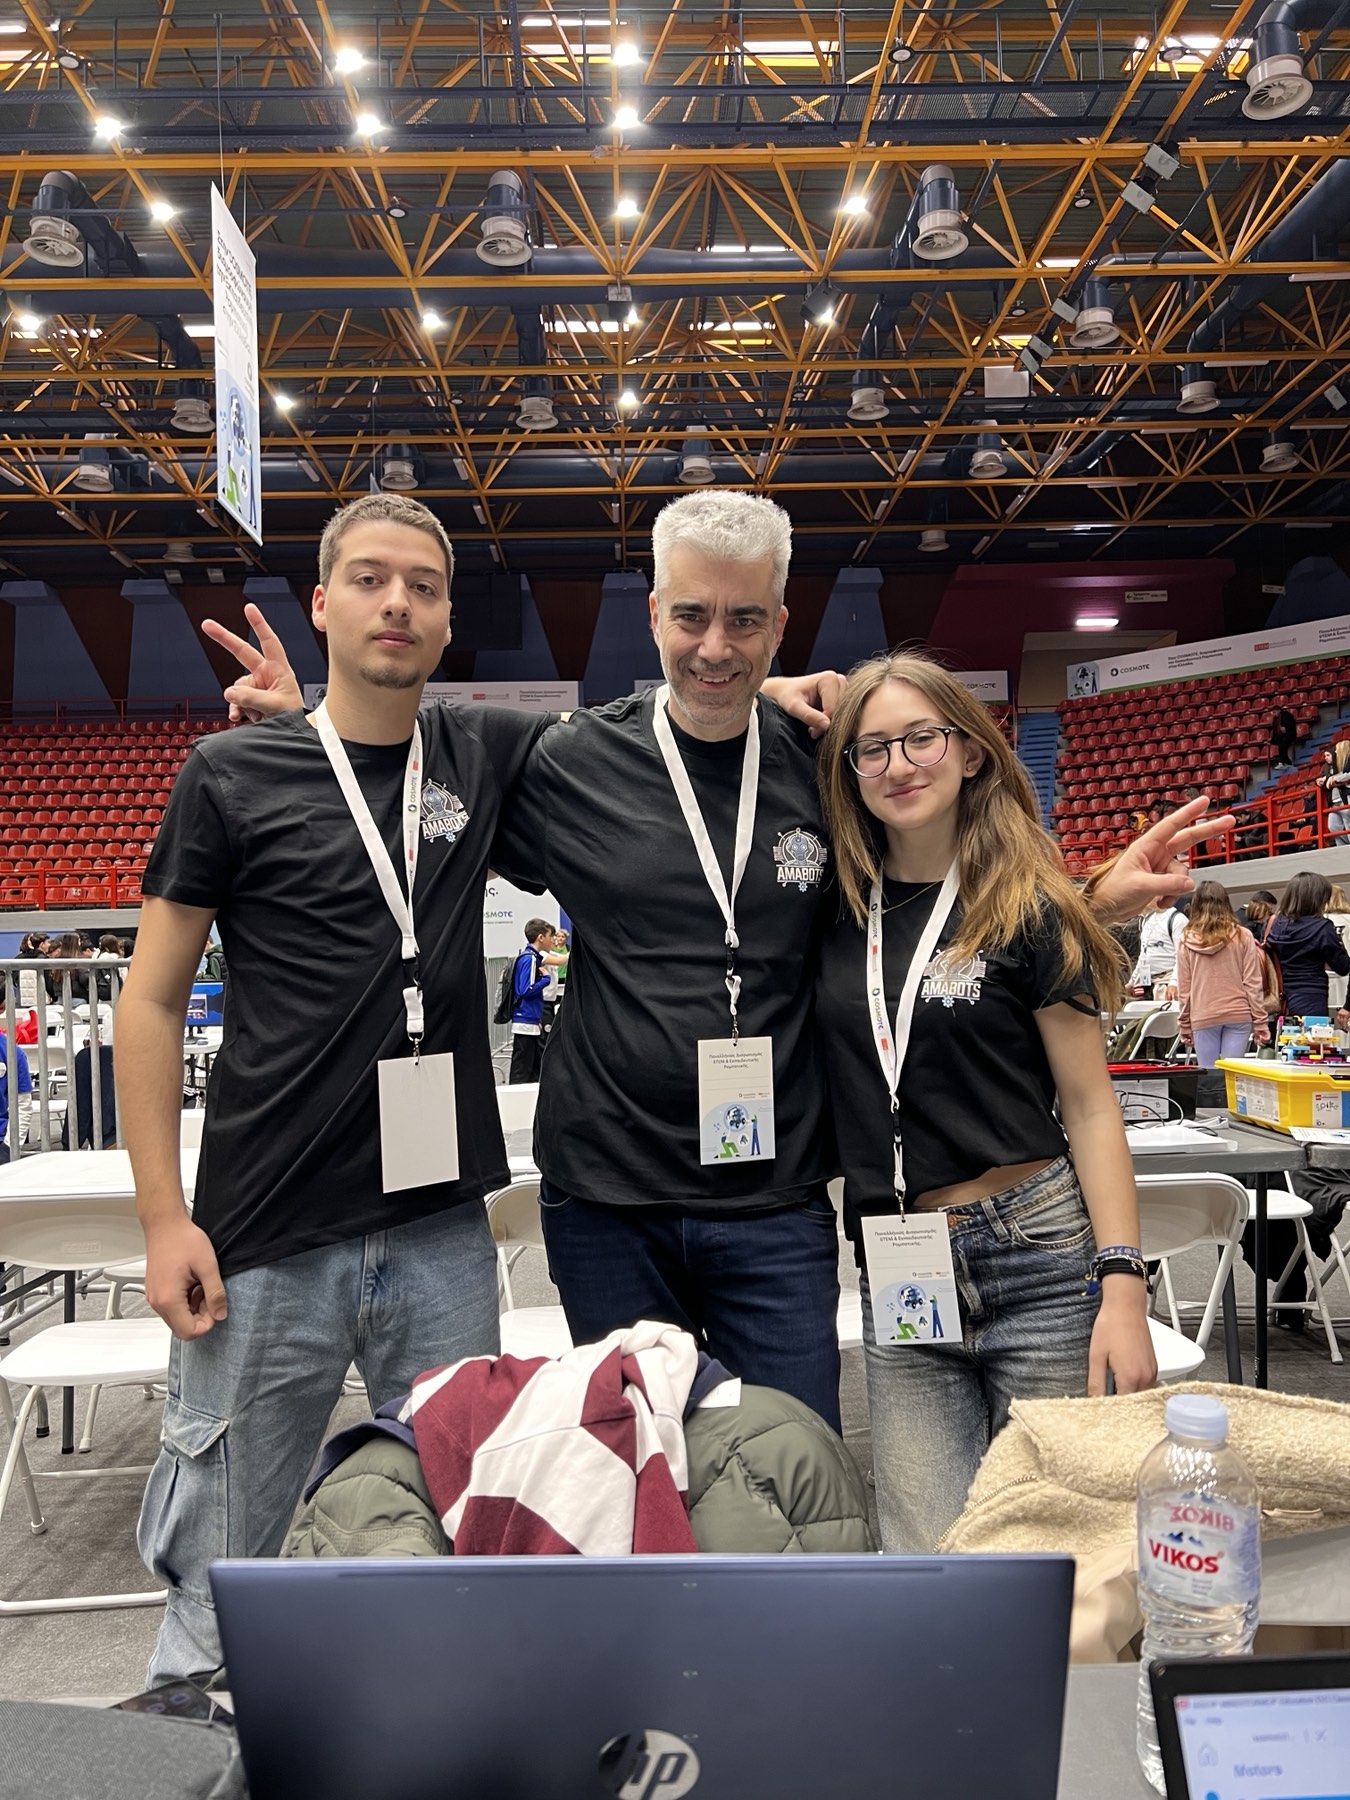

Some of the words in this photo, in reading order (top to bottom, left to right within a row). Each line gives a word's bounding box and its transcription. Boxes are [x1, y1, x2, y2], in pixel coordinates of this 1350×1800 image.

[1120, 664, 1150, 674] COSMOTE
[410, 776, 418, 803] COSMOTE
[422, 811, 470, 837] AMABOTS
[921, 981, 981, 998] AMABOTS
[874, 998, 884, 1030] COSMOTE
[1149, 1538, 1219, 1574] VIKOS
[1233, 1764, 1283, 1777] Motors
